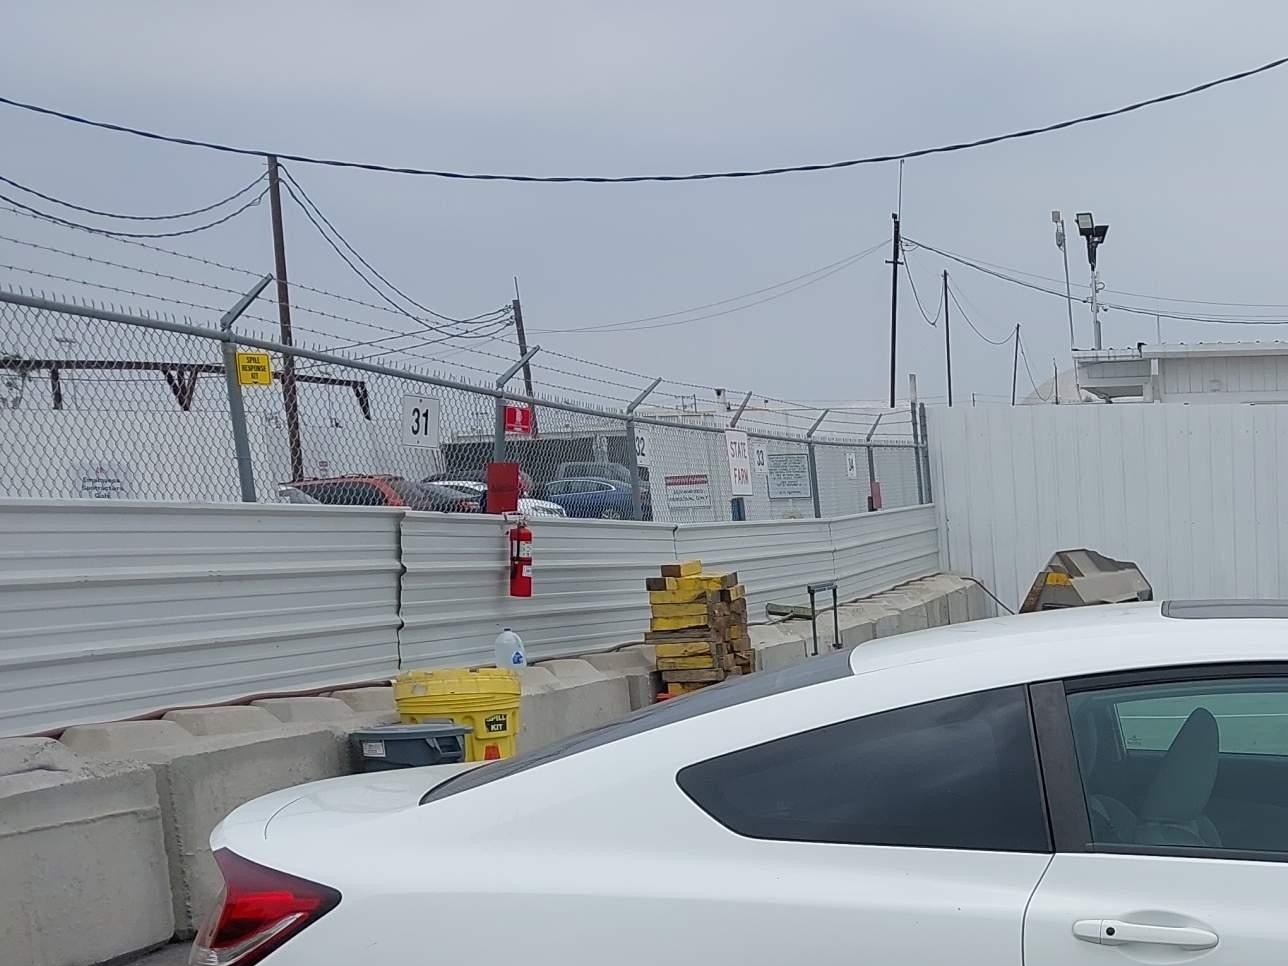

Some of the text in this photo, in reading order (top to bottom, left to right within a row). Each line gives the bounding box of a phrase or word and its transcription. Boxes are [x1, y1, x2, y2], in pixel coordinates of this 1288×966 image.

[240, 364, 267, 372] RESPONSE
[246, 356, 260, 364] SPILL
[411, 407, 429, 436] 31
[635, 436, 645, 456] 32
[730, 441, 747, 459] STATE
[756, 449, 765, 466] 33
[734, 467, 749, 485] FARM
[490, 723, 504, 731] KIT
